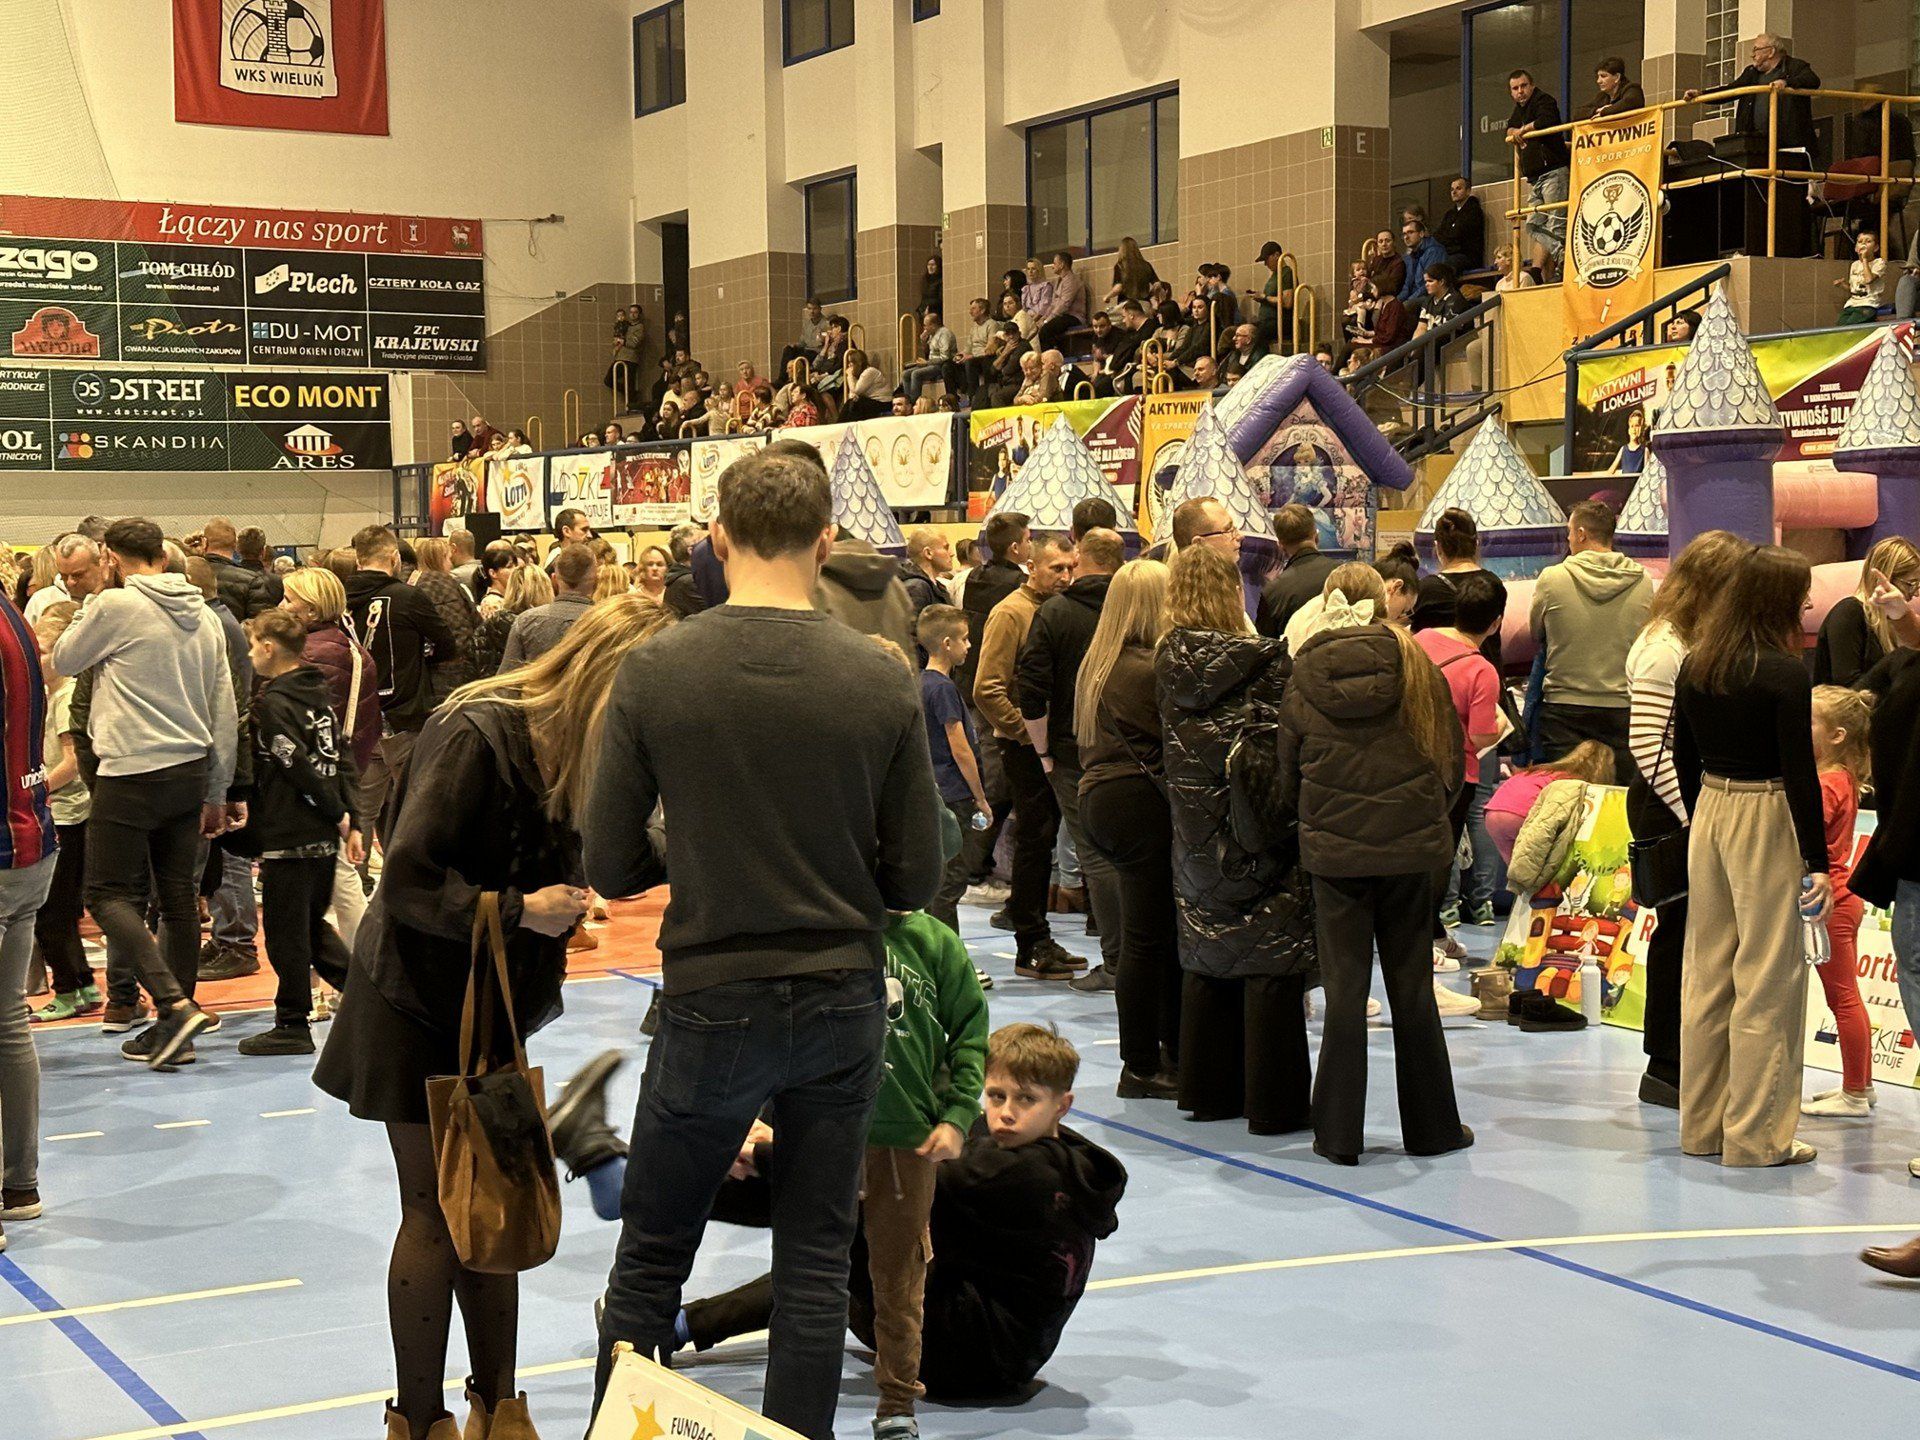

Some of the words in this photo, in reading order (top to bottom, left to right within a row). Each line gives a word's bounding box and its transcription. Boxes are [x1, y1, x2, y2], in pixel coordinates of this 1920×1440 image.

[235, 68, 265, 82] WKS
[271, 71, 324, 87] WIELUŃ
[1356, 132, 1367, 154] E
[1576, 121, 1656, 150] AKTYWNIE
[158, 207, 246, 244] Łączy
[254, 219, 305, 240] nas
[311, 224, 388, 249] sport
[138, 261, 235, 279] TOM-CHŁÓD
[288, 272, 358, 295] Plech
[369, 277, 416, 288] CZTERY
[420, 280, 453, 290] KOŁA
[456, 281, 481, 291] GAZ
[137, 318, 241, 341] Piotr
[270, 322, 299, 339] DU
[314, 325, 363, 342] MOT
[413, 325, 440, 336] ZPC
[170, 347, 204, 355] UDANYCH
[205, 347, 242, 356] ZAKUPÓW
[252, 345, 297, 356] CENTRUM
[299, 347, 327, 357] OKIEN
[333, 348, 364, 358] DRZWI
[374, 336, 480, 352] KRAJEWSKI
[381, 351, 417, 361] Tradycyjne
[418, 353, 449, 362] pieczywo
[109, 378, 205, 401] DSTREET
[1590, 369, 1642, 401] AKTYWNI
[235, 385, 291, 408] ECO
[298, 385, 382, 409] MONT
[1602, 381, 1656, 414] LOKALNIE
[1831, 406, 1852, 424] DLA
[0, 430, 42, 450] OL
[271, 455, 355, 469] ARES
